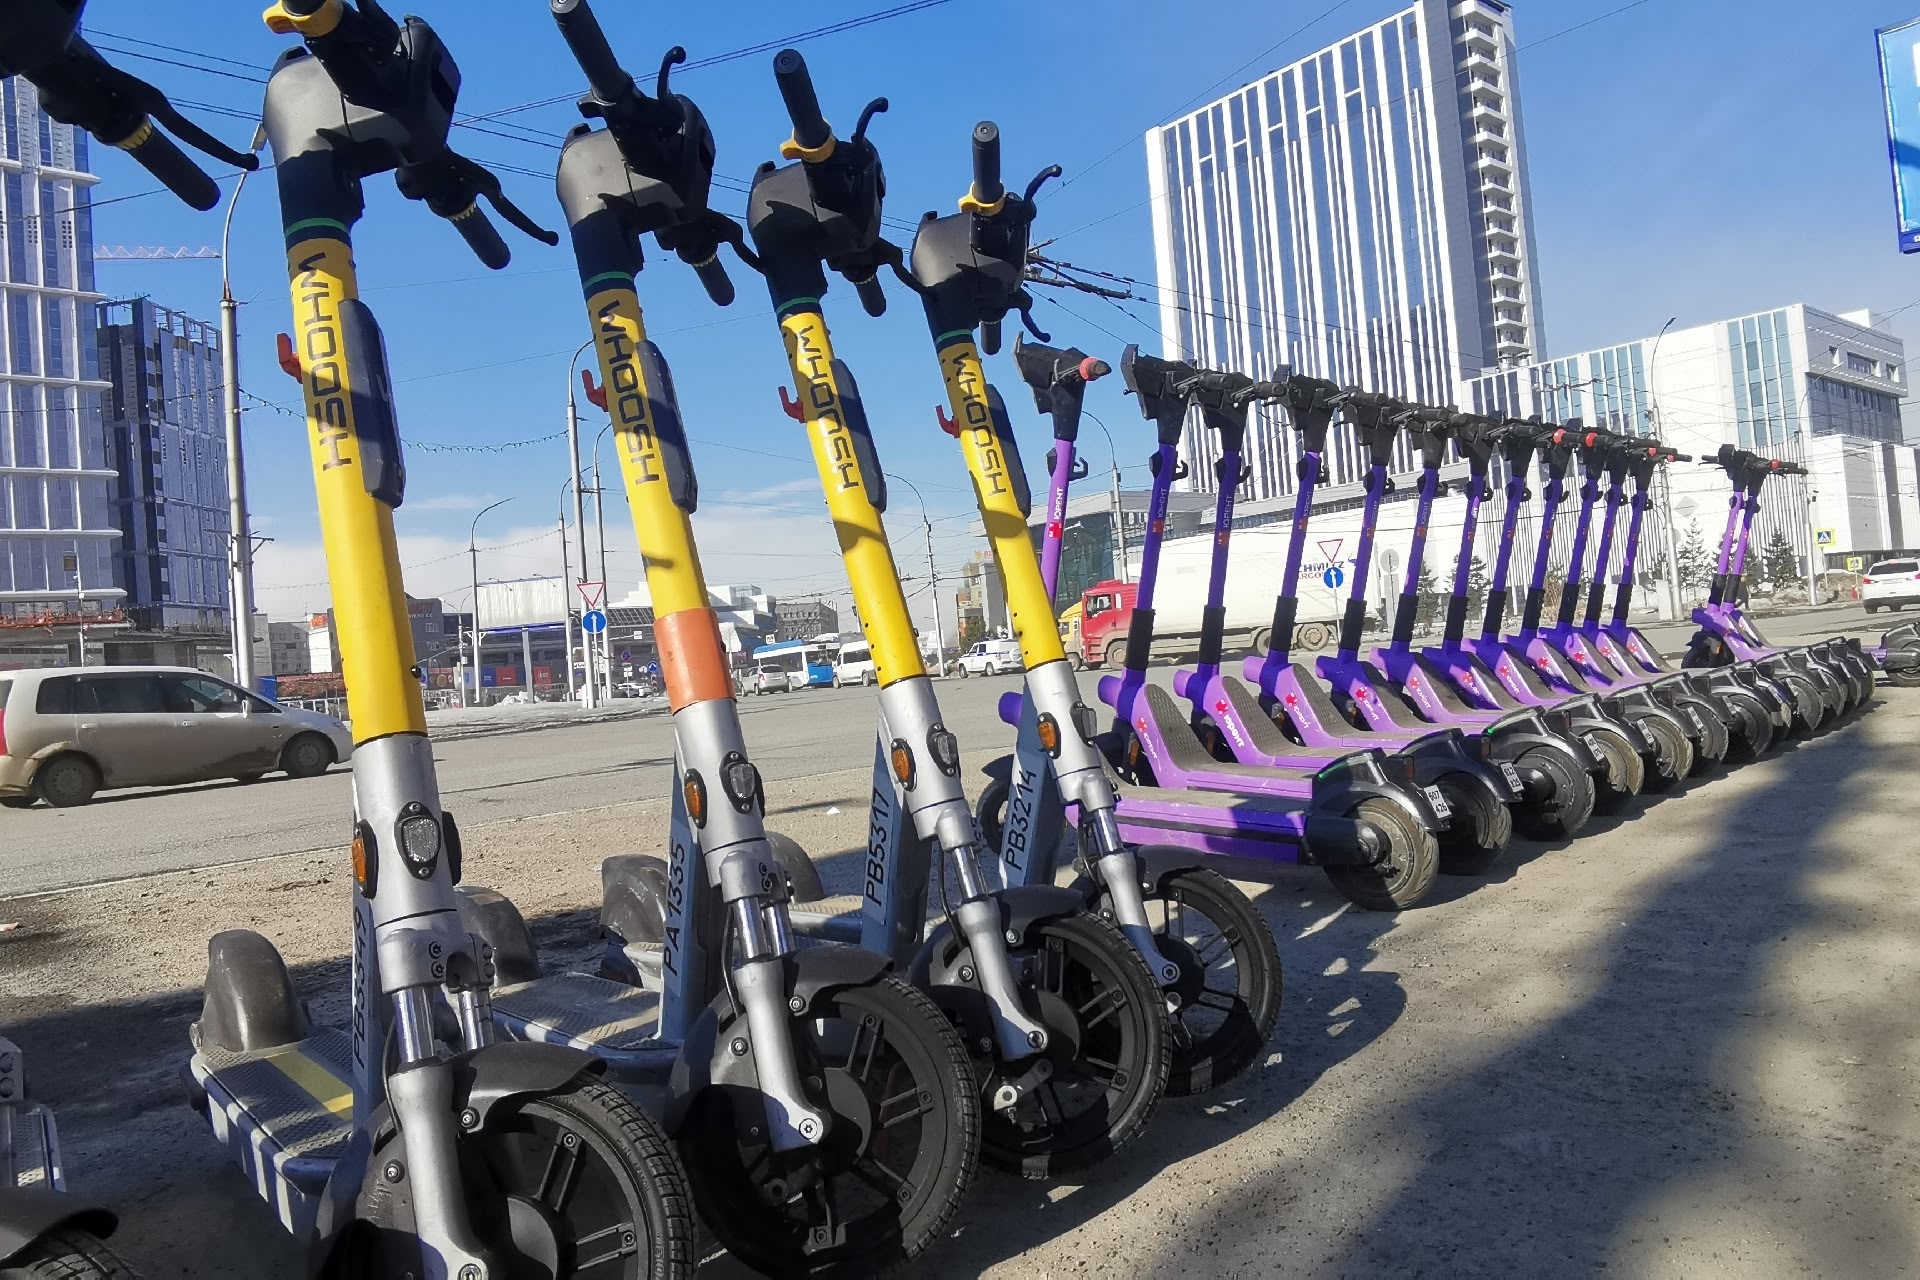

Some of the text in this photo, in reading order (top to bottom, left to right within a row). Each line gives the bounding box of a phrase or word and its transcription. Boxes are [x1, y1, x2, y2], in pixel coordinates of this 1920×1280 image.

[297, 252, 353, 472] WHOOSH
[598, 299, 660, 486] WHOOSH
[798, 325, 859, 489] WHOOSH
[952, 351, 1007, 497] WHOOSH
[865, 786, 890, 907] PB5317
